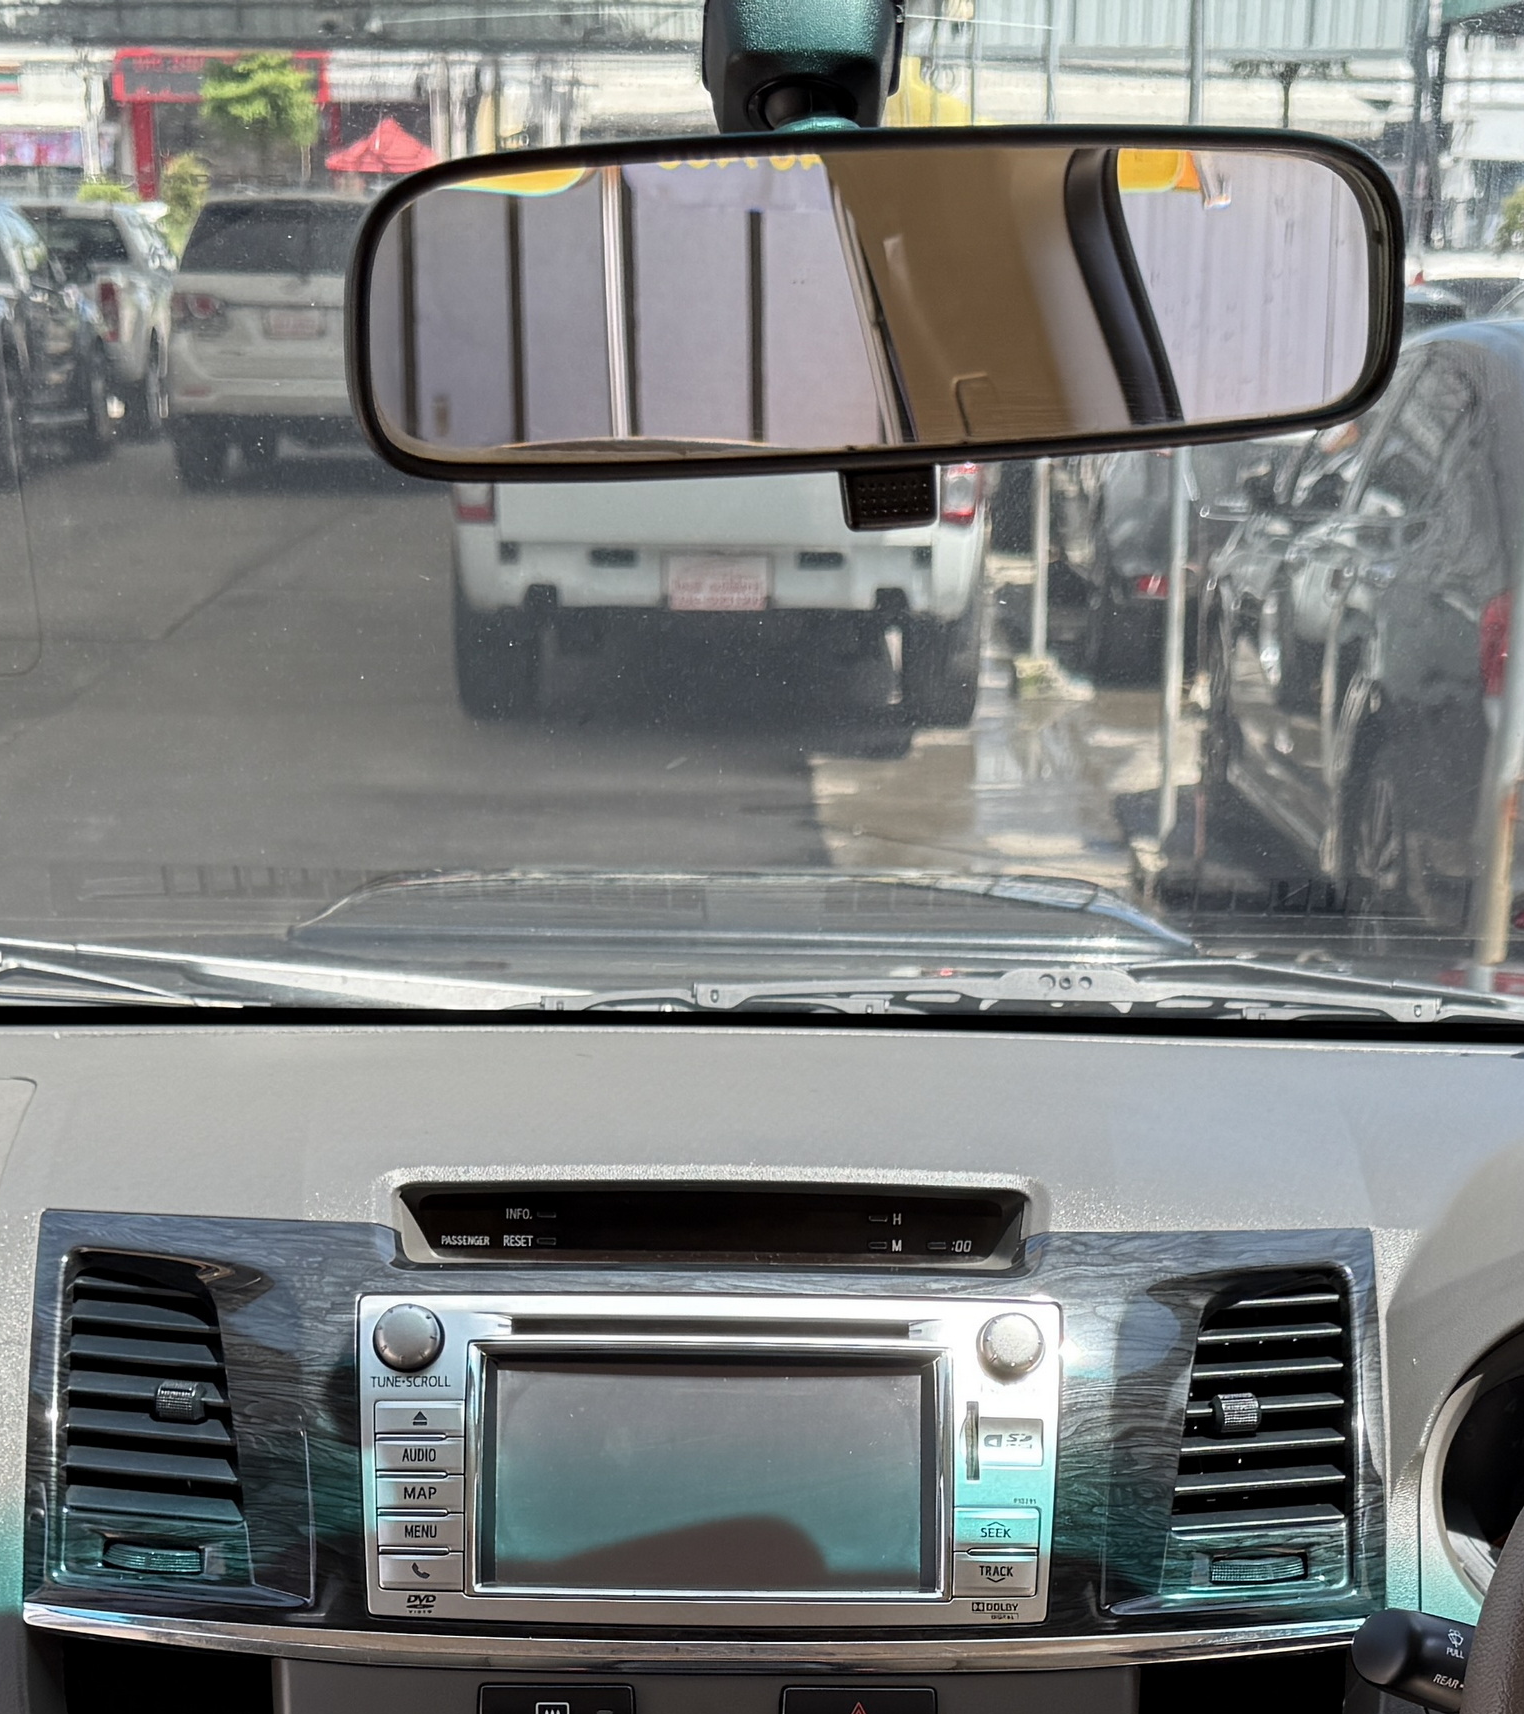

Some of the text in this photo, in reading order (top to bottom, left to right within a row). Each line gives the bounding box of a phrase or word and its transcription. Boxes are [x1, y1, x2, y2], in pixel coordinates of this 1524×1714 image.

[505, 1208, 533, 1220] INFO.
[892, 1213, 902, 1225] H
[441, 1235, 490, 1246] PASSENGER
[503, 1235, 534, 1247] RESET
[892, 1239, 902, 1252] M
[402, 1448, 437, 1462] AUDIO
[403, 1486, 437, 1500] MAP
[404, 1525, 438, 1539] MENU
[980, 1527, 1011, 1538] SEEK
[979, 1565, 1014, 1577] TRACK
[407, 1594, 437, 1604] DVD
[986, 1602, 1018, 1611] DOLBY
[1446, 1647, 1464, 1660] PULL
[1433, 1674, 1459, 1689] REAR
